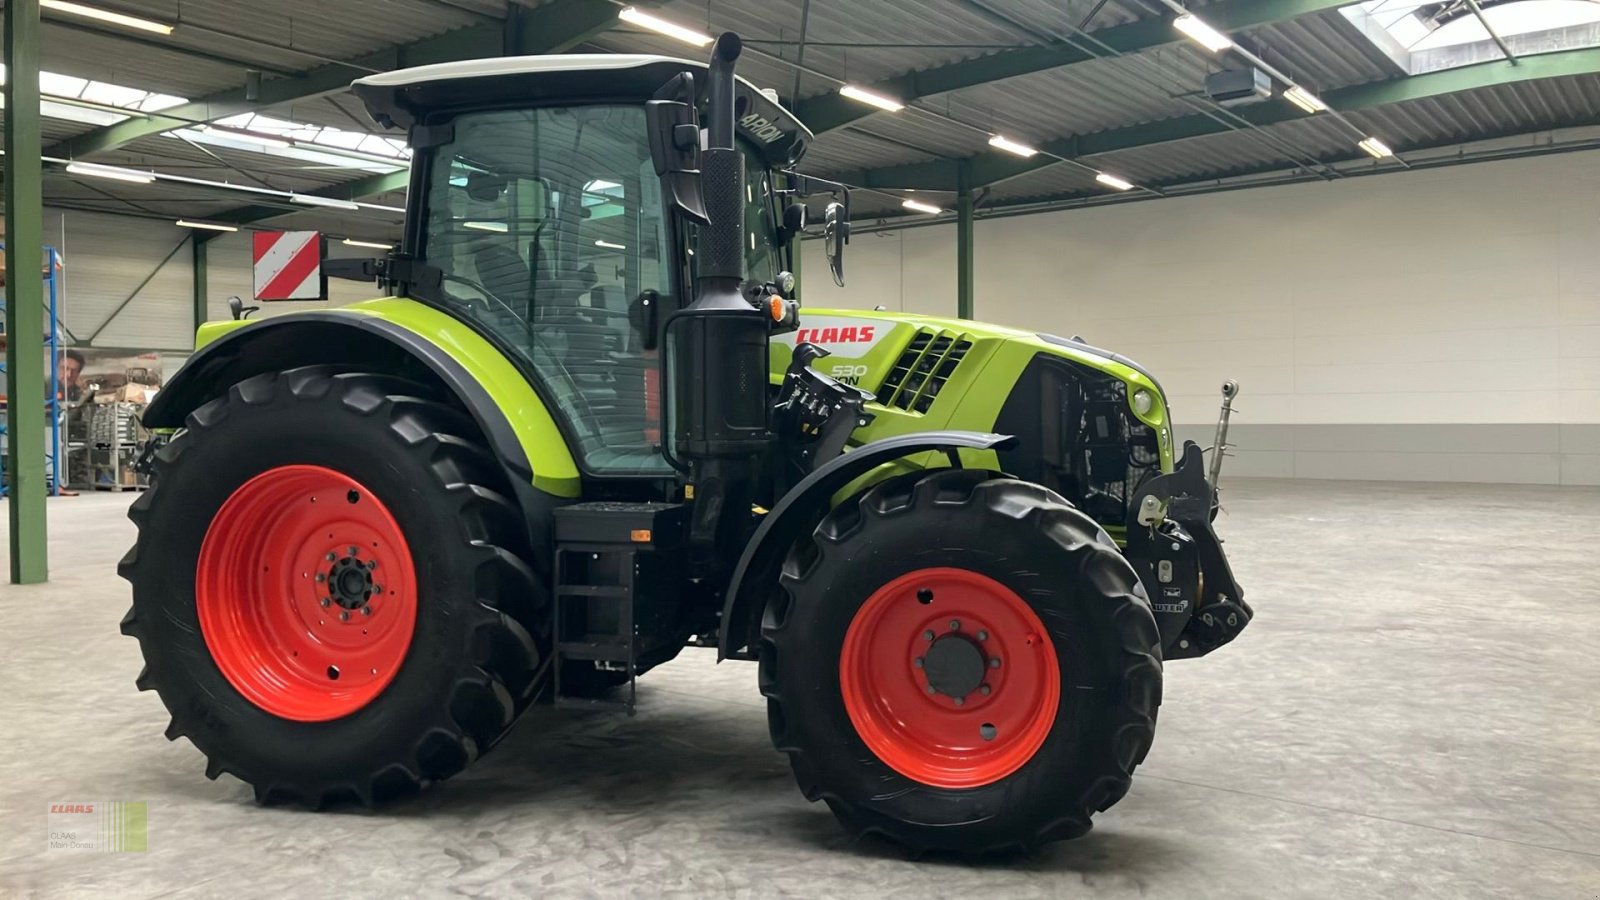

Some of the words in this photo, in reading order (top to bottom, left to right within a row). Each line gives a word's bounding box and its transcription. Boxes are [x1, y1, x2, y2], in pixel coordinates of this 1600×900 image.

[741, 113, 785, 143] ARION
[796, 326, 875, 345] CLAAS
[831, 365, 868, 376] 530
